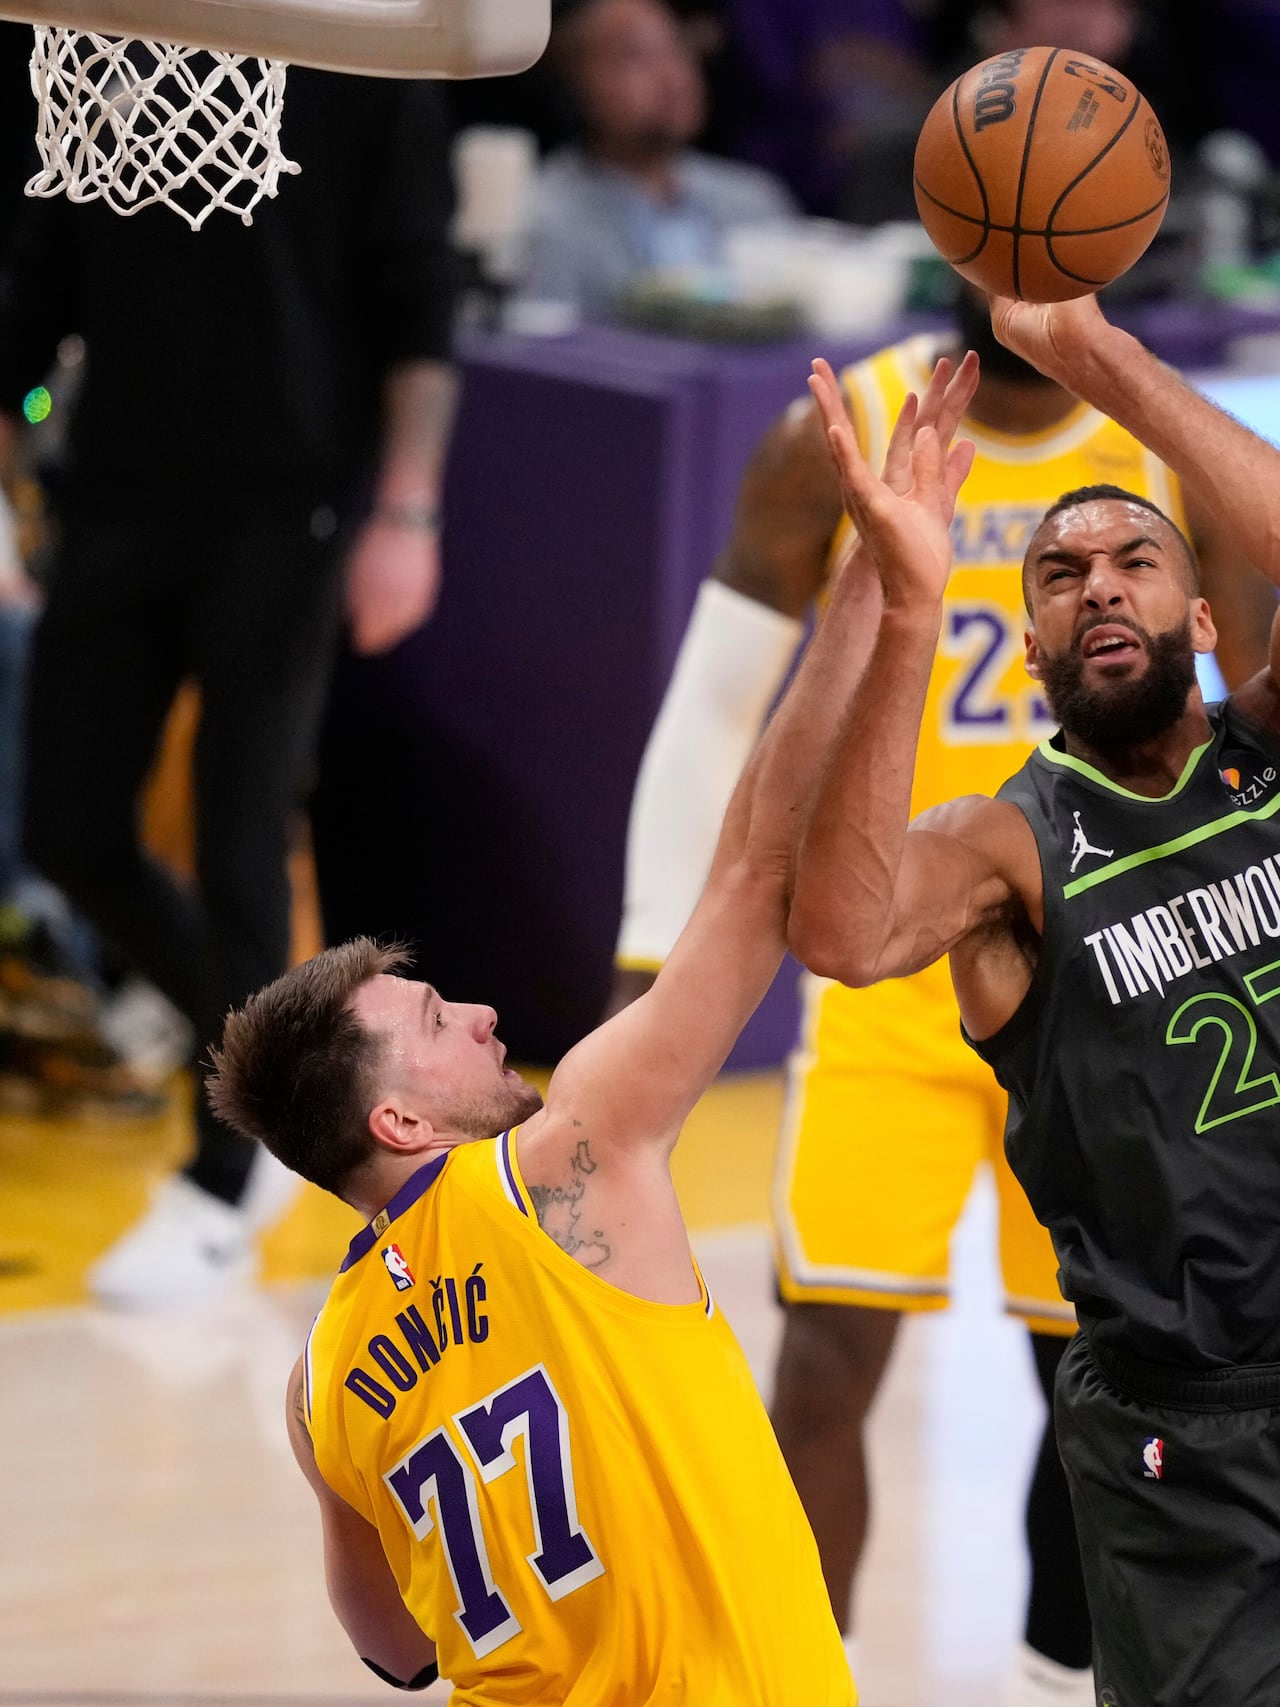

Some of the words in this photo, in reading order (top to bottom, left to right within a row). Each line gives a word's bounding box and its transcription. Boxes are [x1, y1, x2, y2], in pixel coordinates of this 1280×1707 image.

[946, 604, 1056, 732] 2
[1230, 766, 1277, 806] ezzle
[344, 1263, 489, 1420] DONČIĆ
[382, 1362, 606, 1660] 77
